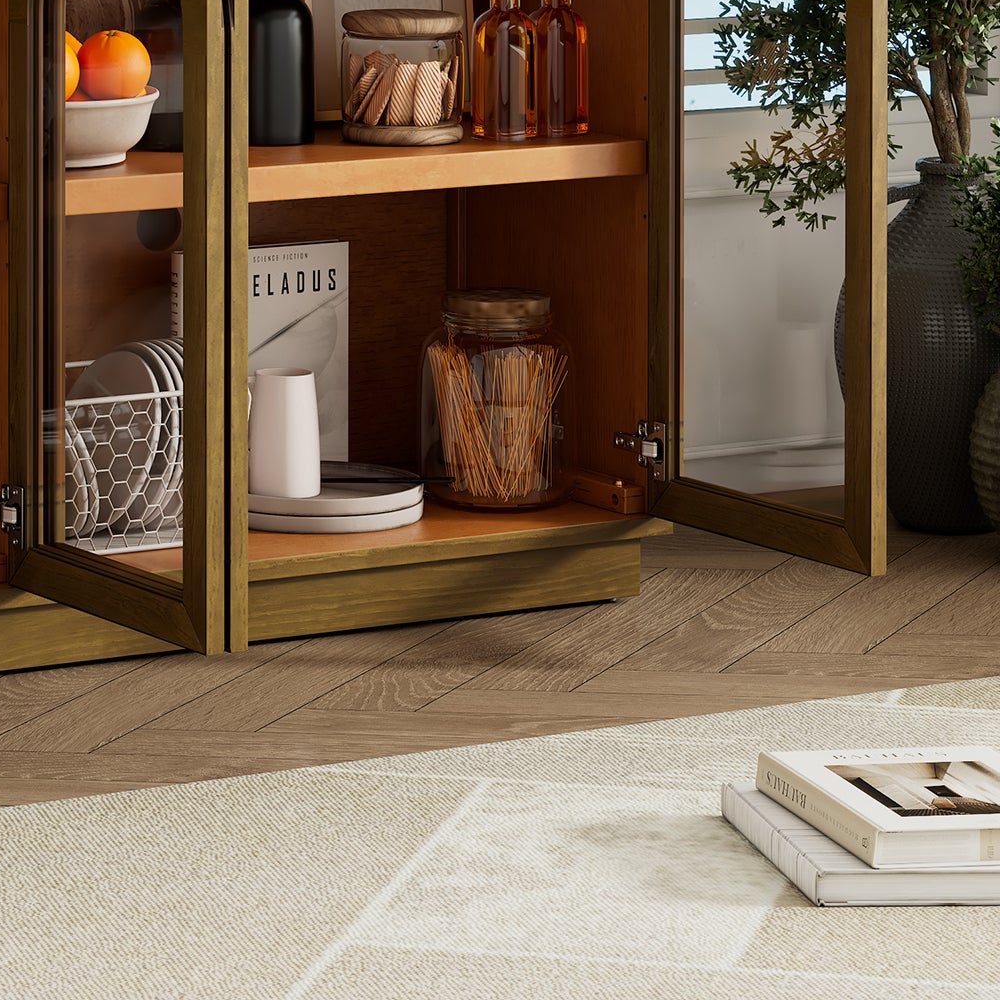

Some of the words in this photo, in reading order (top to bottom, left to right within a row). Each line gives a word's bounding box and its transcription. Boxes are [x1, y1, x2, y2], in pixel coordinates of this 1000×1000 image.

[253, 254, 279, 263] SCIENCE
[283, 253, 308, 261] FICTION
[253, 268, 336, 297] ELADUS
